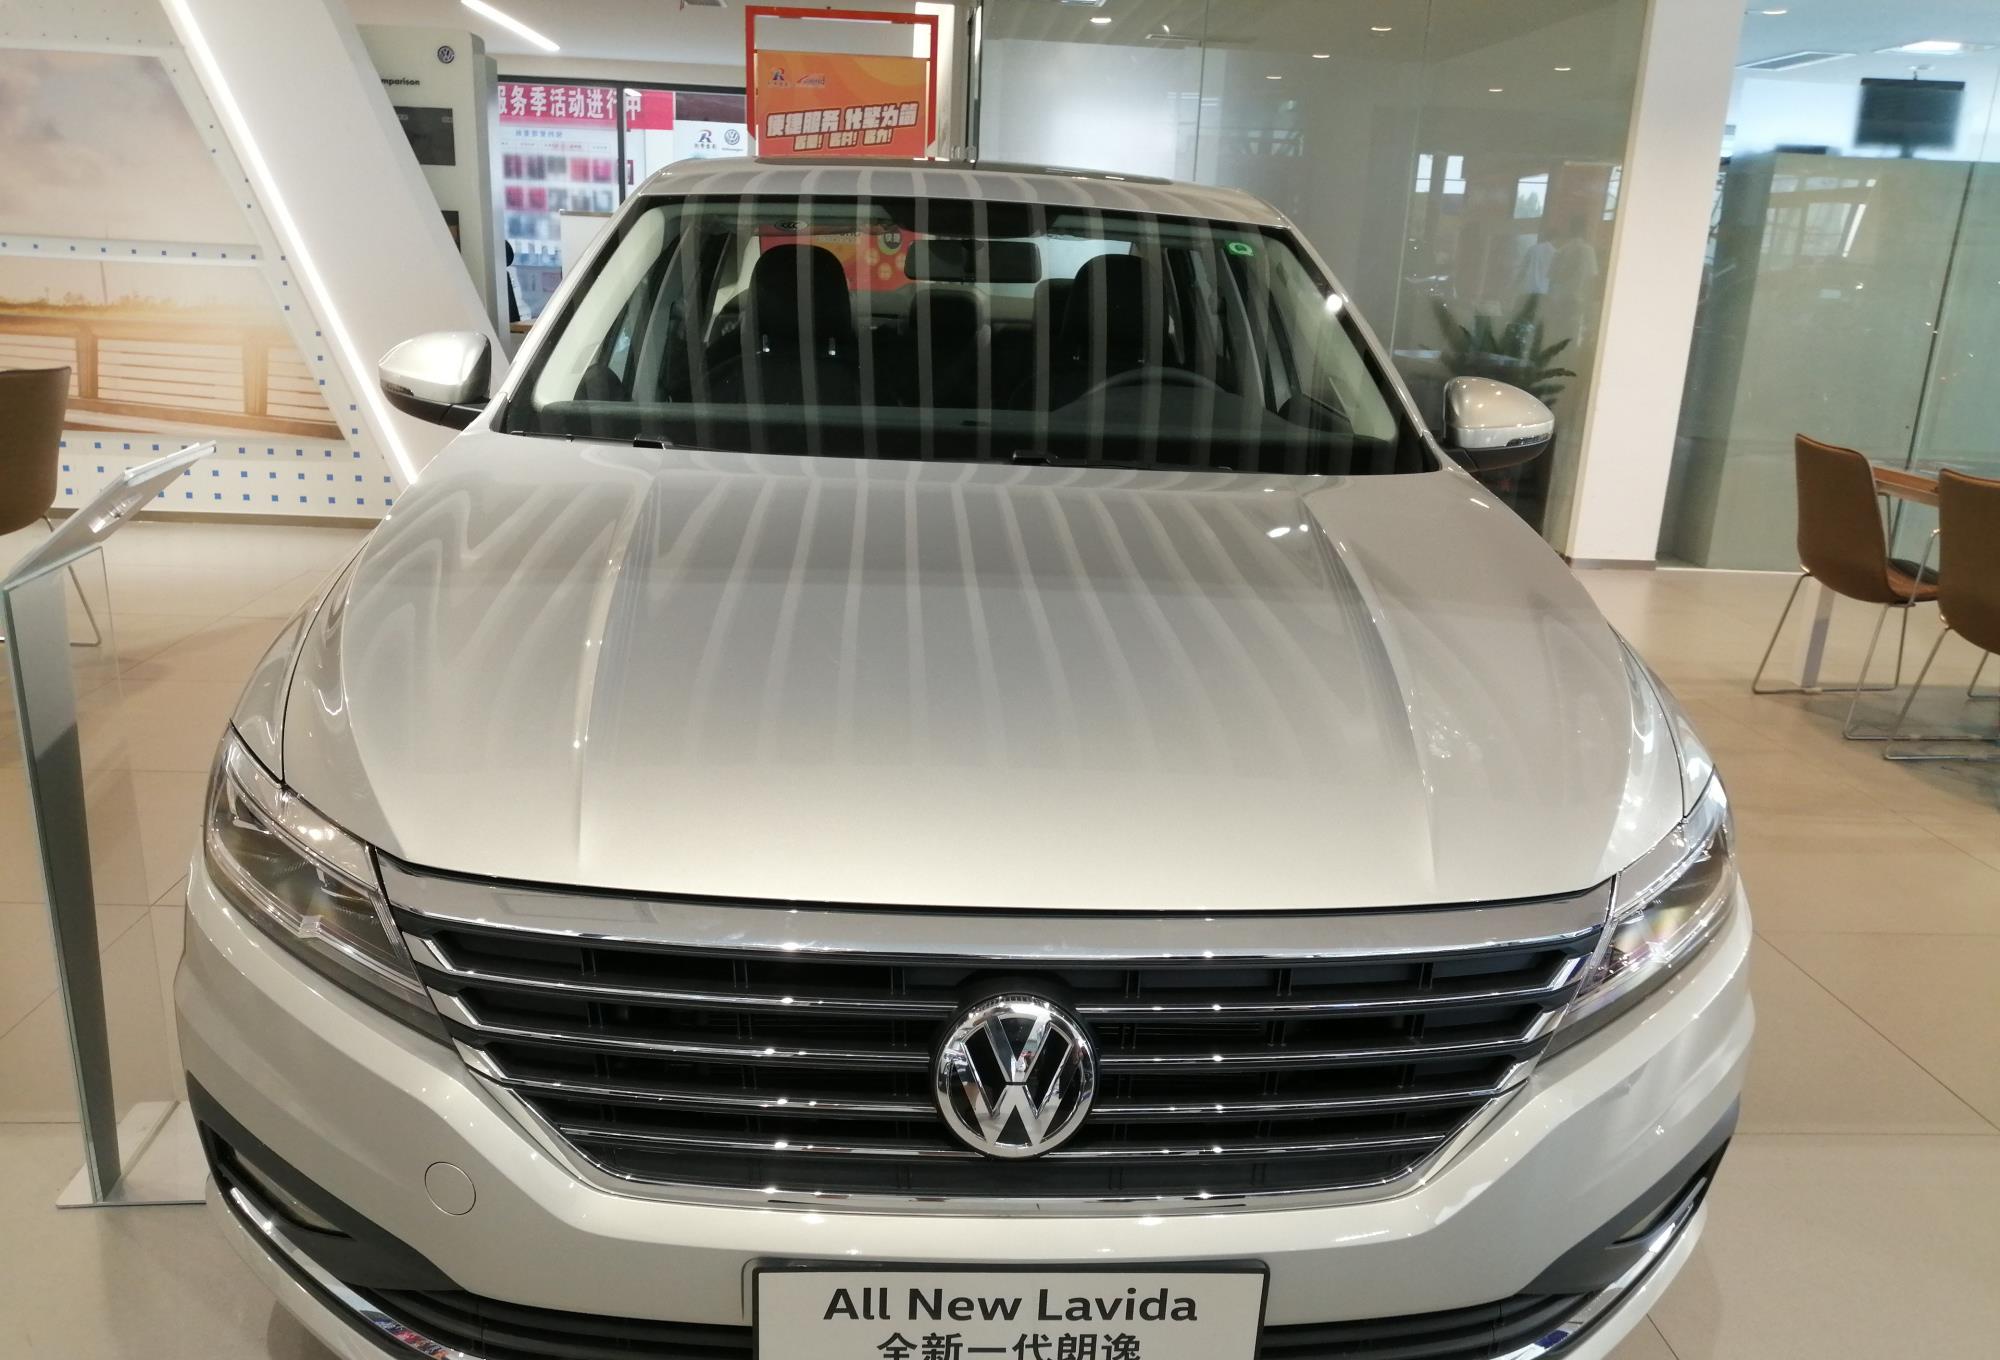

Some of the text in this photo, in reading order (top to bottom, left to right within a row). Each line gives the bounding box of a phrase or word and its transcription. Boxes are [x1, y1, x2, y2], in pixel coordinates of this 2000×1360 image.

[824, 1287, 1197, 1321] All New Lavida
[877, 1332, 1141, 1360] 全新一代朗逸
